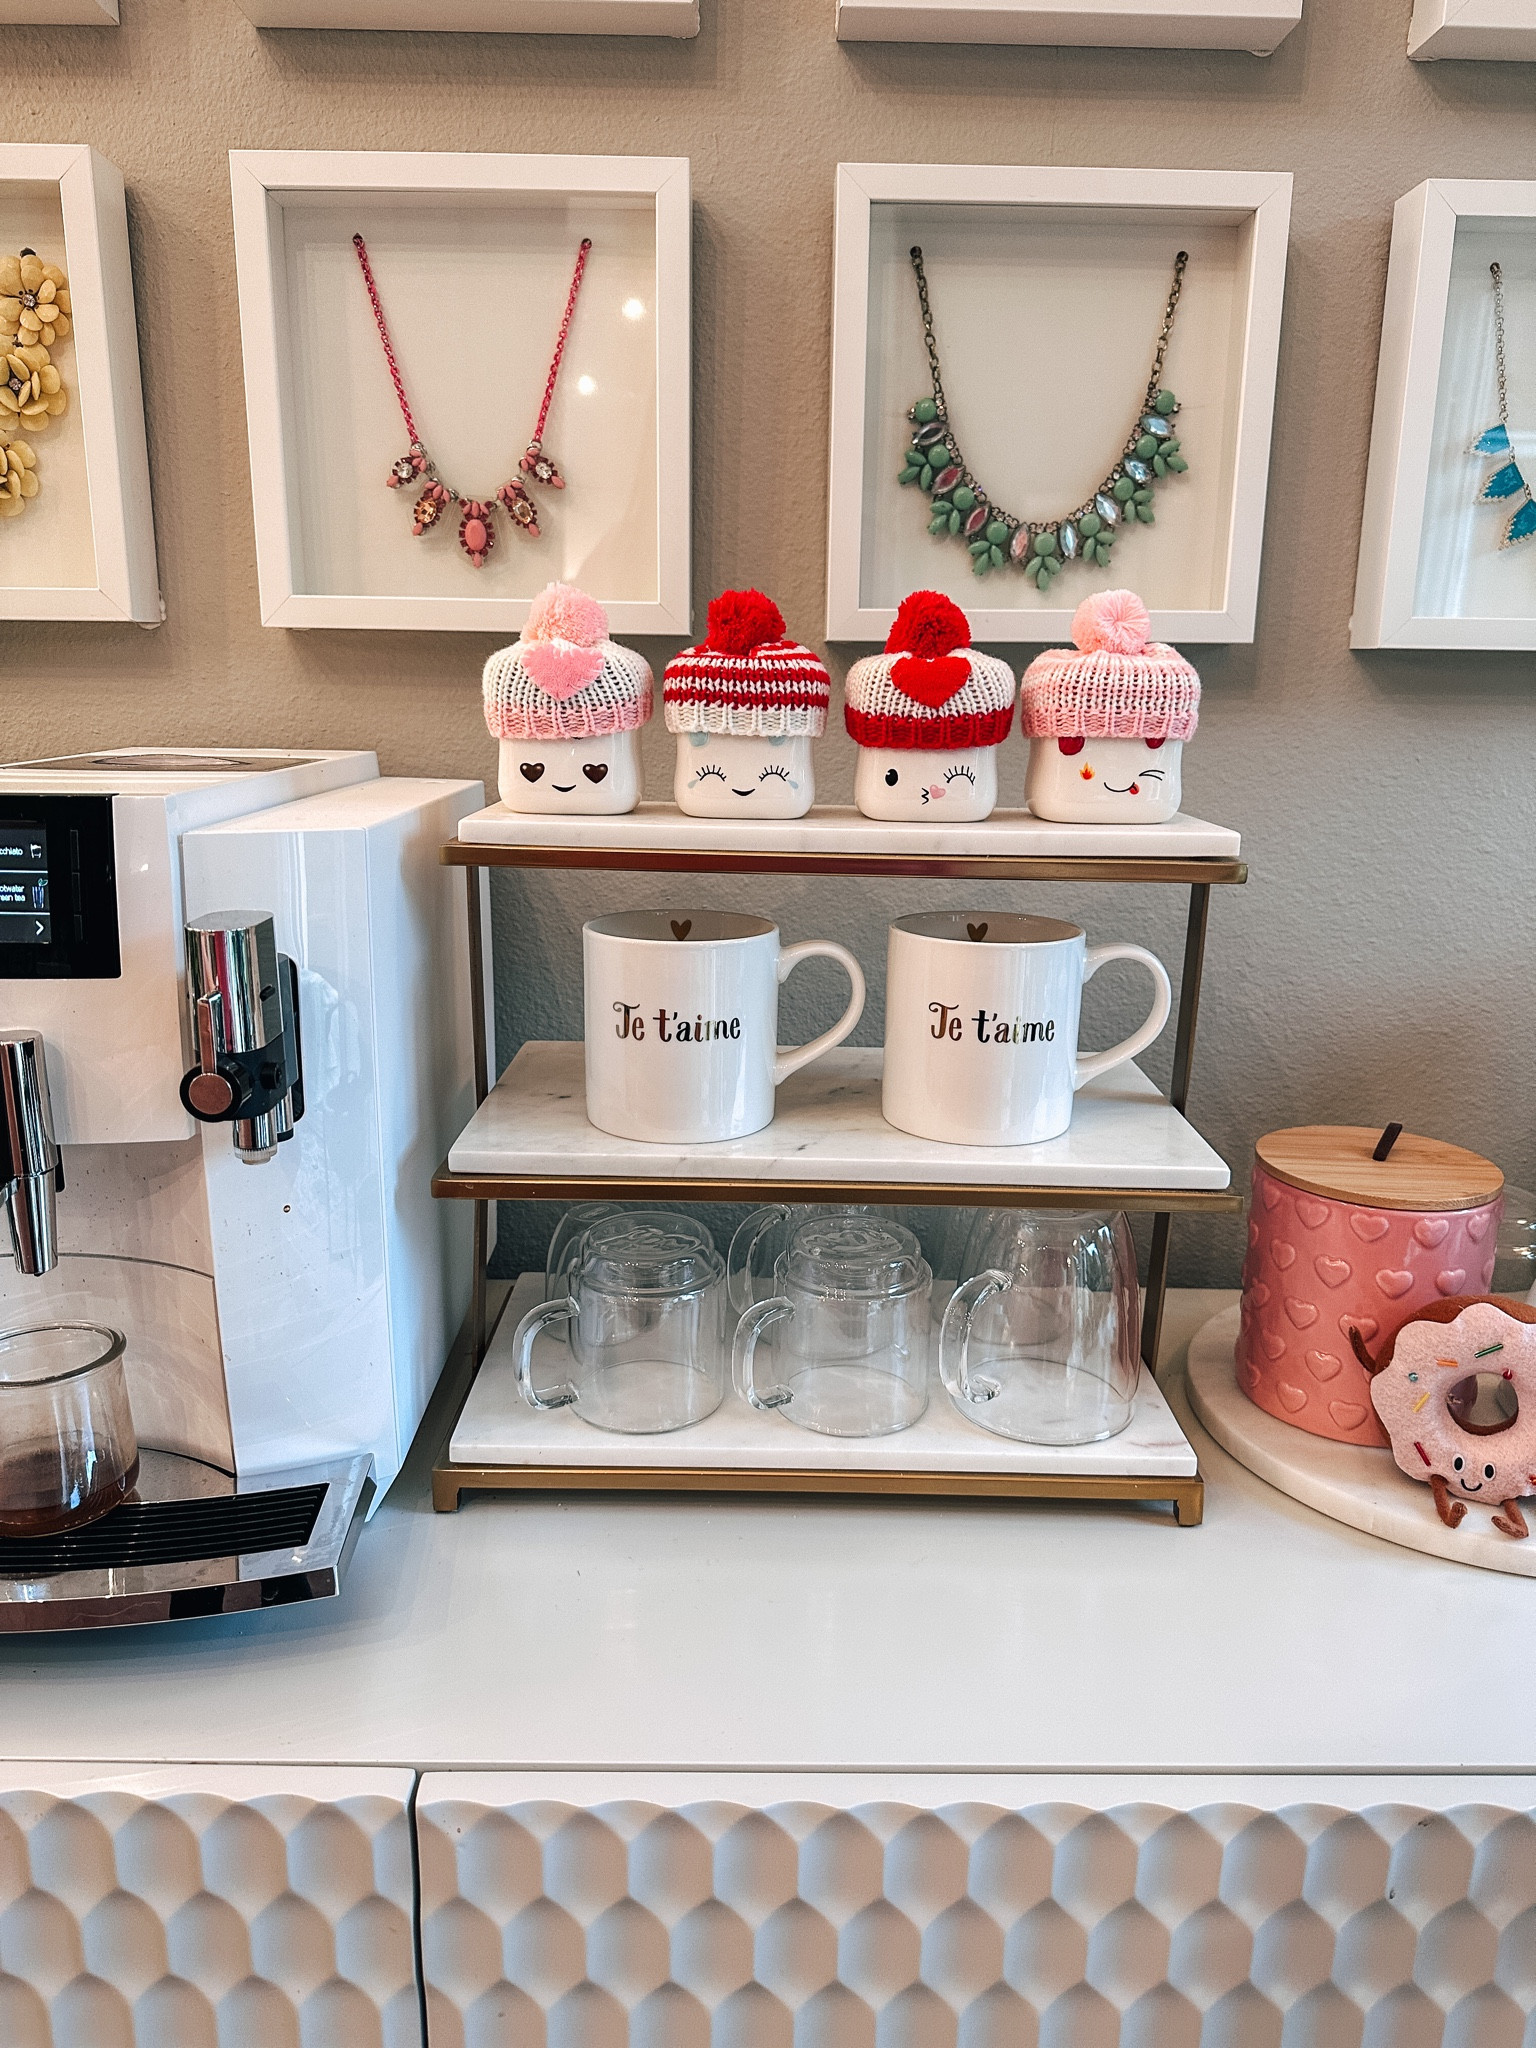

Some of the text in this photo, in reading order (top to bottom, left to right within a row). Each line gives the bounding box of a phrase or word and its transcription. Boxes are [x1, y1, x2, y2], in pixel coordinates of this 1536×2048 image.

[14, 894, 25, 902] tea
[612, 1001, 741, 1042] Je t'aime
[928, 1001, 1055, 1043] Je t'aime
